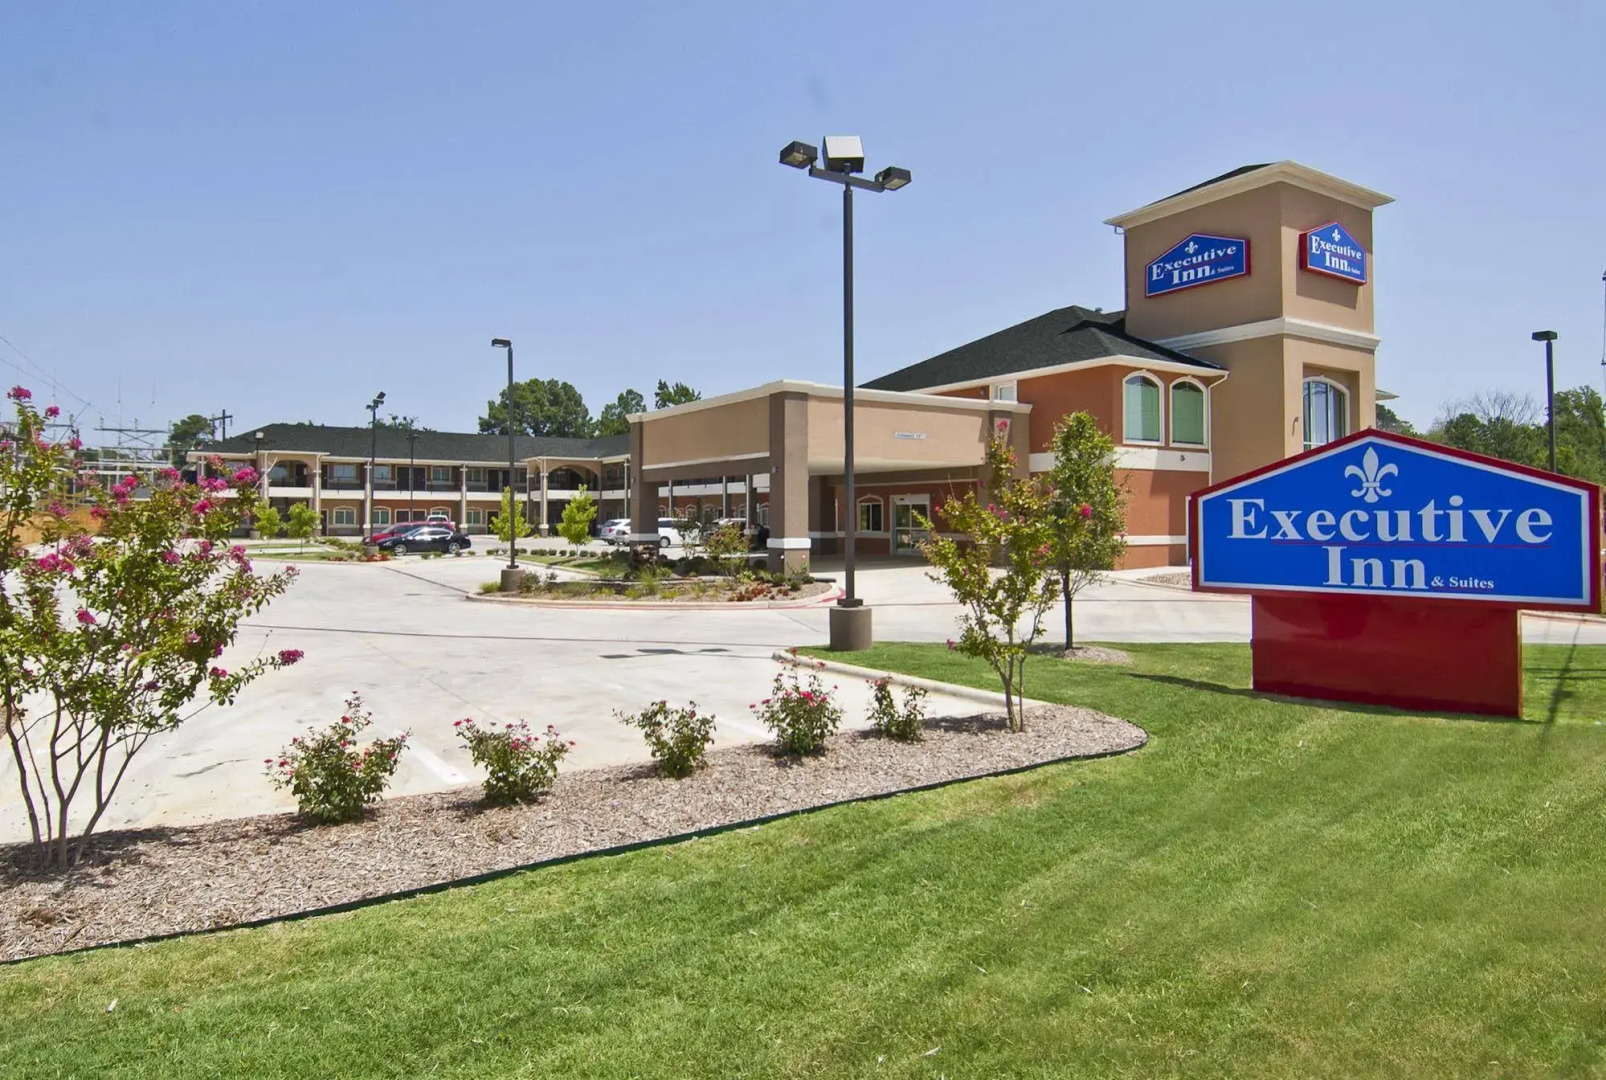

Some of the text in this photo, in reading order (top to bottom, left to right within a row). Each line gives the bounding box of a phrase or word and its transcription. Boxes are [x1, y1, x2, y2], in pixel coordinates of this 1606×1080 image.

[1310, 234, 1362, 260] Executive
[1324, 252, 1349, 272] Inn
[1151, 246, 1238, 281] Executive
[1171, 264, 1212, 285] Inn
[1226, 495, 1553, 544] Executive
[1323, 546, 1495, 590] Inn & Suites
